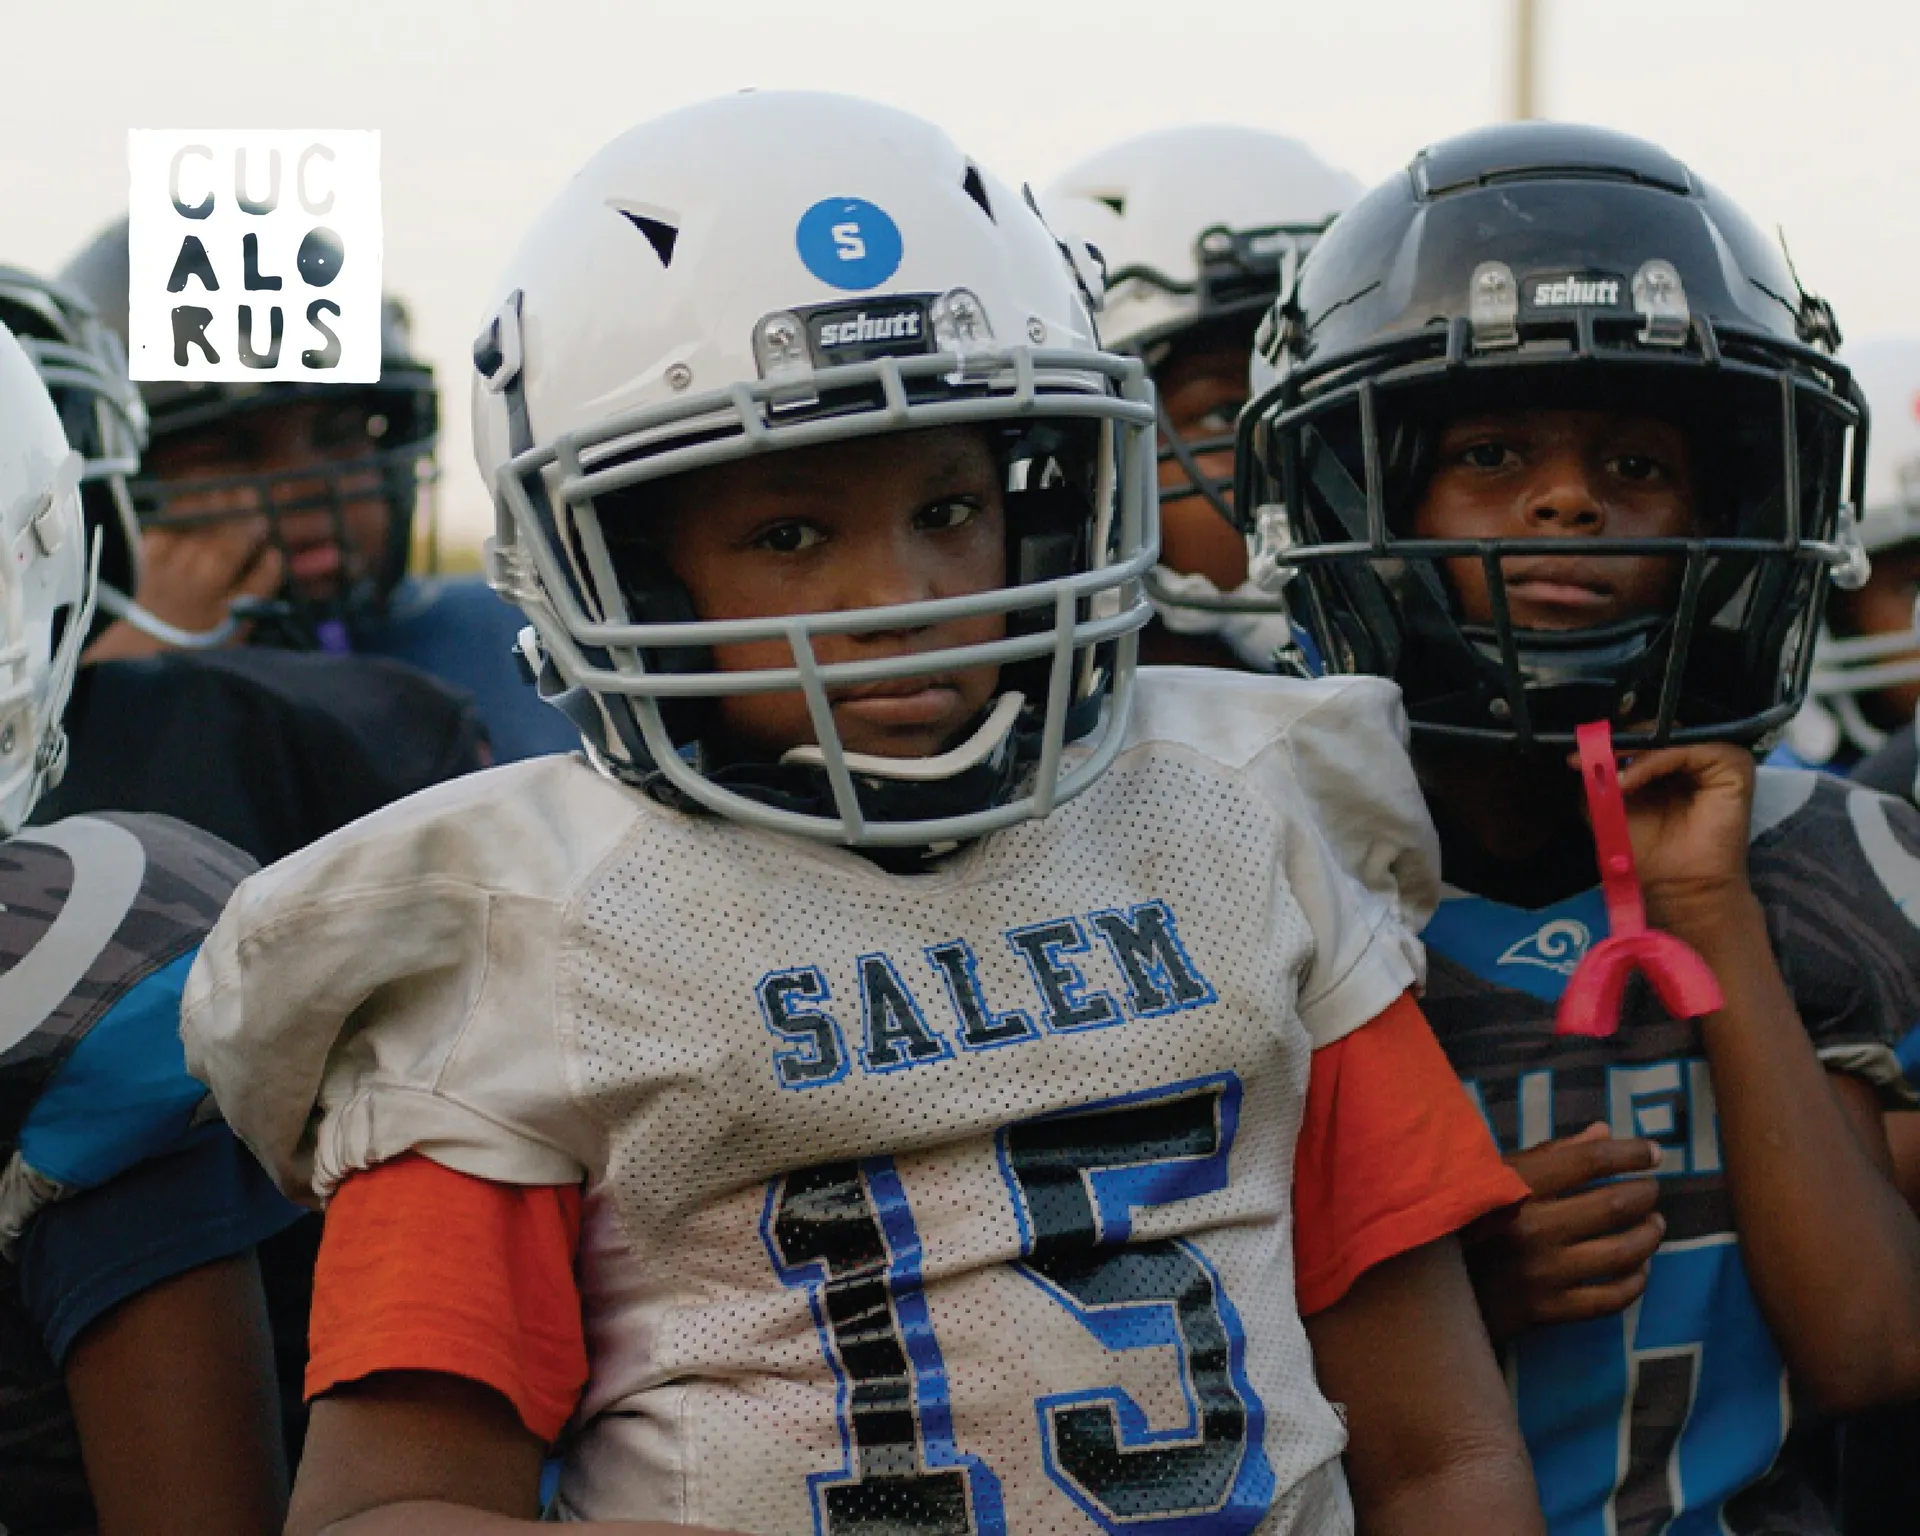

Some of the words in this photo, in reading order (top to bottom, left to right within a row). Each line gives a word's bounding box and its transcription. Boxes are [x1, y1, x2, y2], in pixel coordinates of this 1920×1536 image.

[831, 222, 866, 261] S
[1535, 276, 1619, 305] schutt
[820, 312, 920, 346] schutt
[757, 899, 1218, 1090] SALEM
[760, 1070, 1276, 1536] 15
